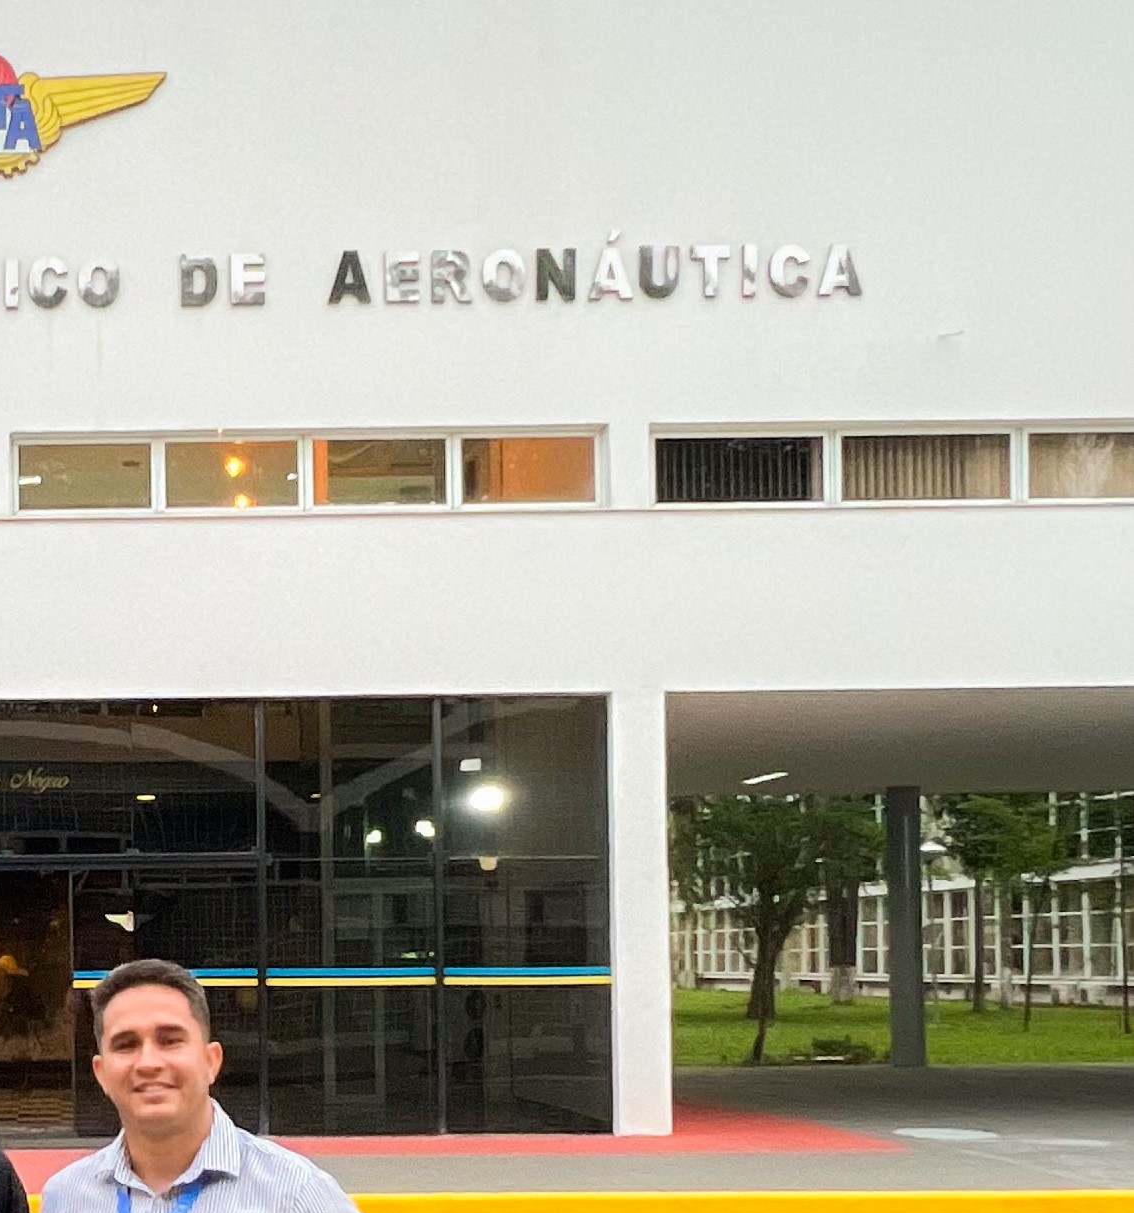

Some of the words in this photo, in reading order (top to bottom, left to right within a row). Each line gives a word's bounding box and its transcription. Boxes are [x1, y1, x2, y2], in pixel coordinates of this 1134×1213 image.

[179, 253, 268, 309] DE
[328, 231, 863, 306] AERONÁUTICA
[10, 766, 71, 795] Negro
